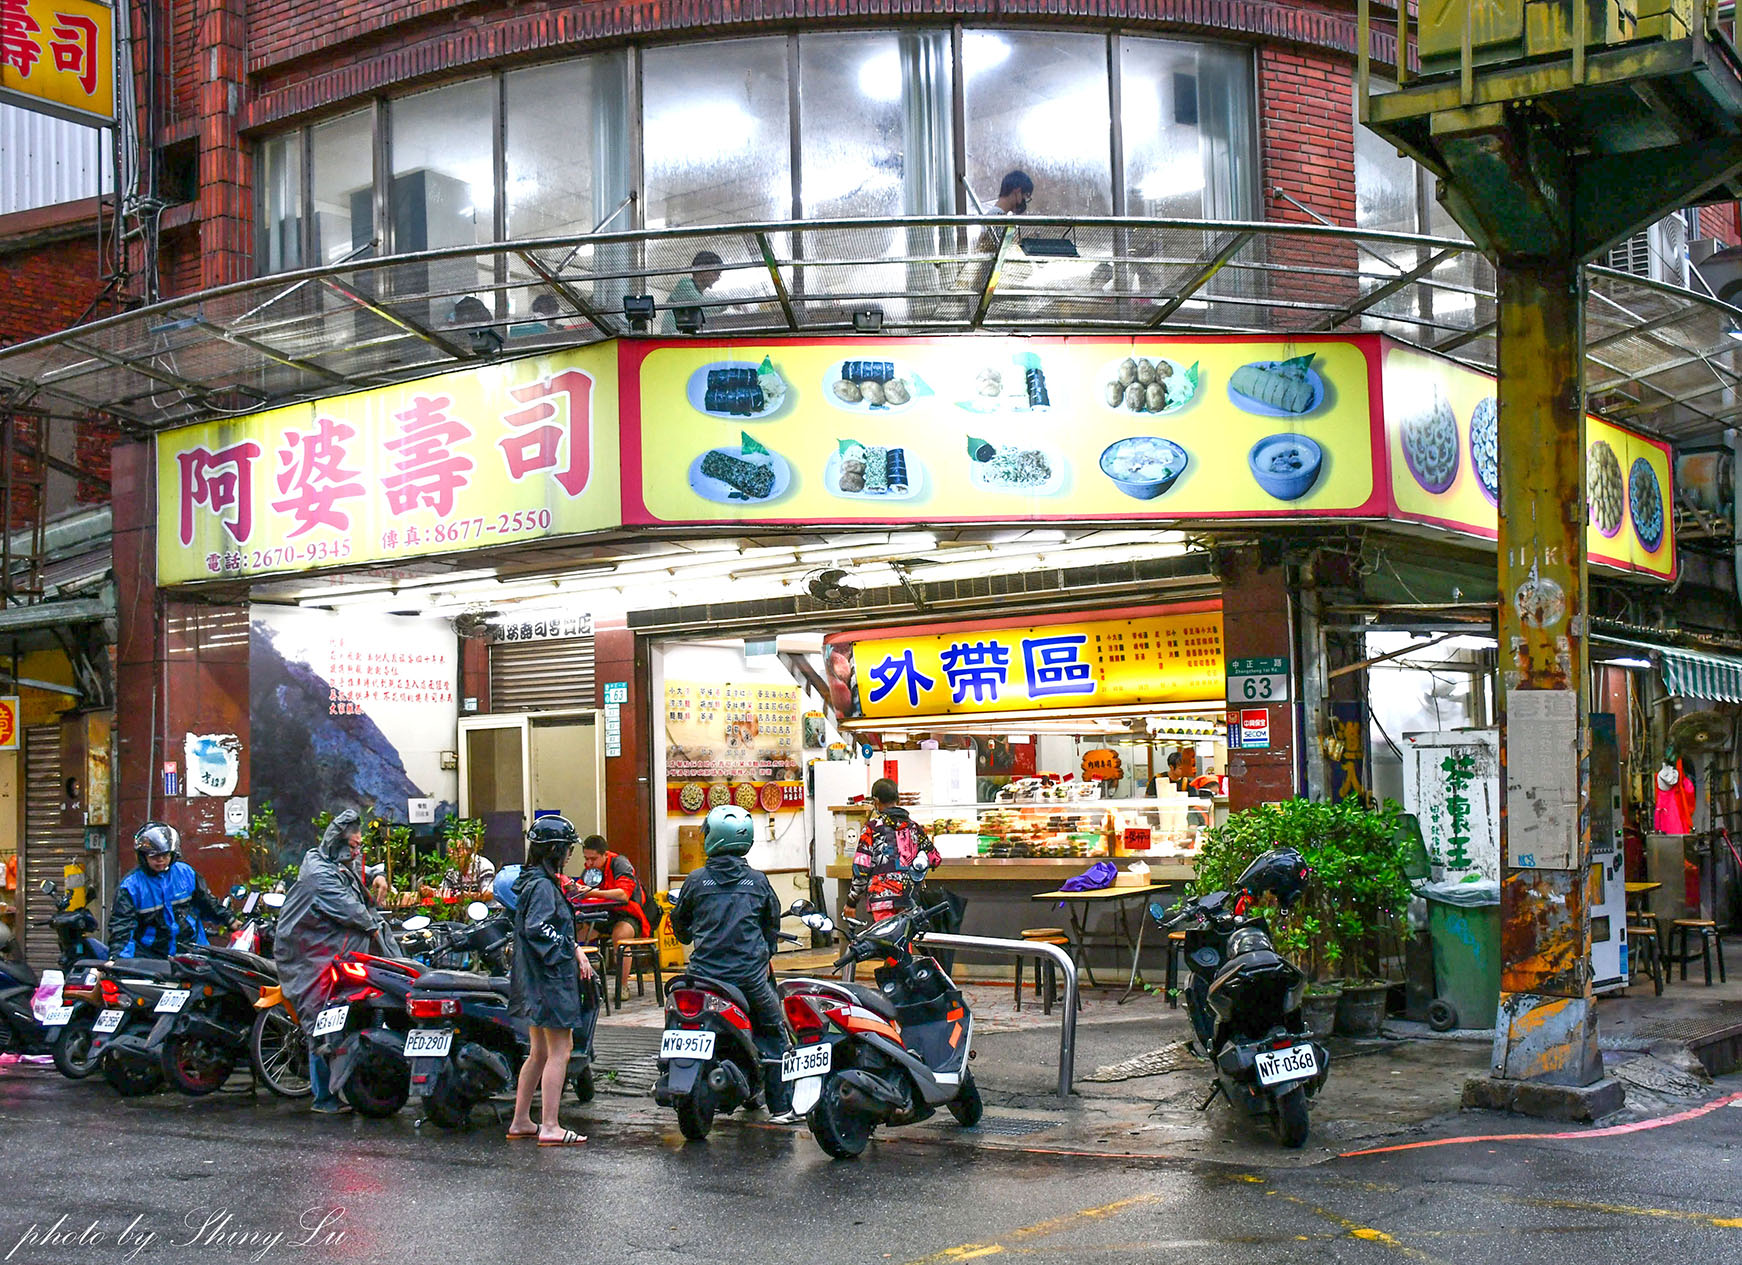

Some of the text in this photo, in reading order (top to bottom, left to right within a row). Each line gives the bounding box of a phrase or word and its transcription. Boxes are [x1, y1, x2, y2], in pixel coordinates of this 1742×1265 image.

[177, 369, 593, 547] 阿婆壽司
[869, 635, 1095, 706] 外帶區
[1232, 658, 1282, 669] 中正一路
[613, 690, 623, 700] 63
[1243, 677, 1273, 700] 63
[1244, 730, 1267, 738] SECOM
[407, 1035, 448, 1051] PED-2901
[662, 1037, 712, 1053] MYQ-9517
[783, 1051, 829, 1075] MXT-3858
[1260, 1053, 1314, 1078] NYF-0368
